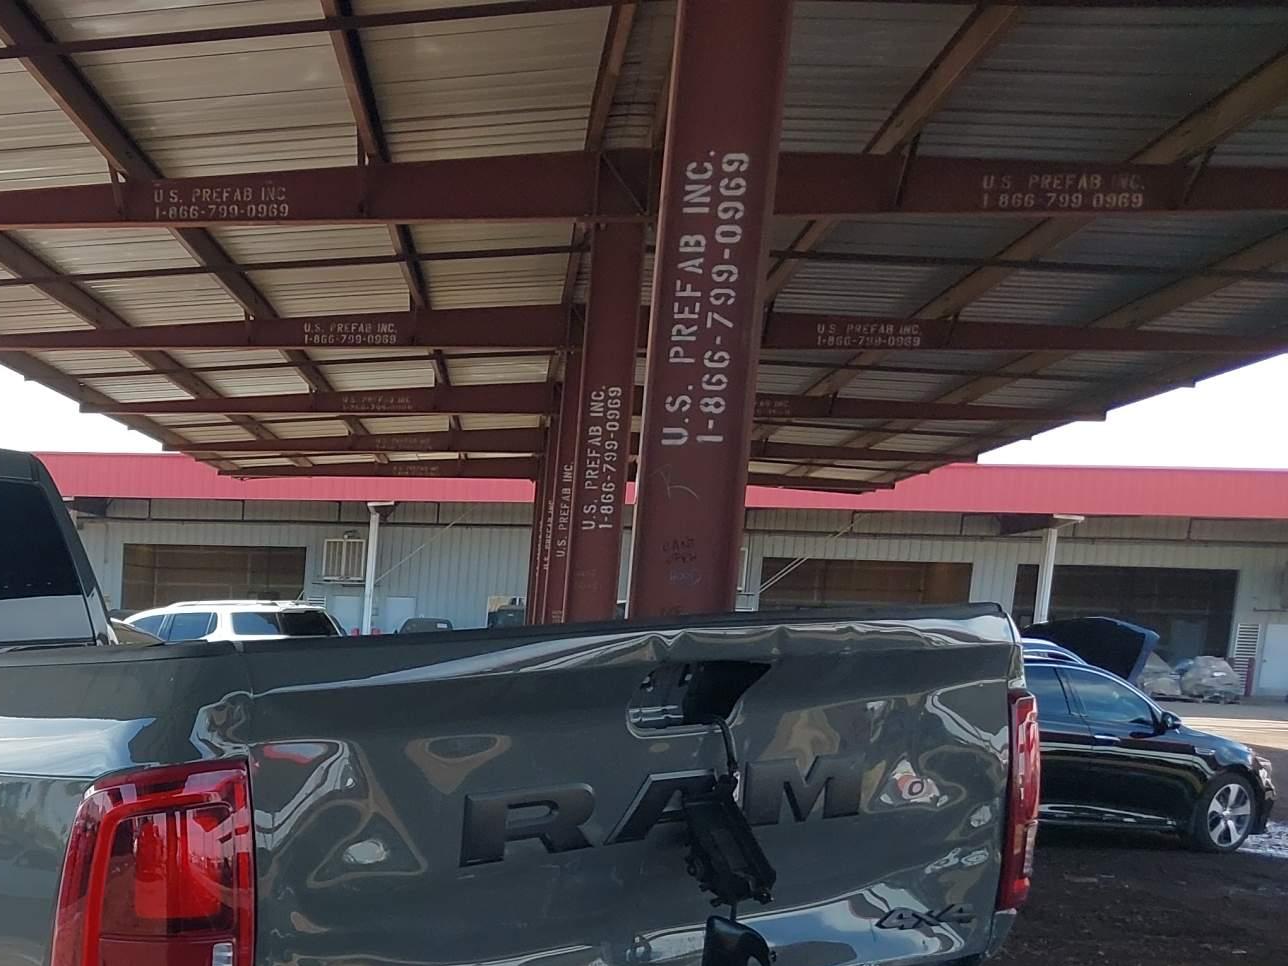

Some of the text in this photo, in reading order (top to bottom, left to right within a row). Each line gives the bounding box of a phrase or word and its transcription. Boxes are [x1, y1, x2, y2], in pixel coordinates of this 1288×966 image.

[154, 189, 183, 204] US.
[192, 187, 252, 203] PREFAB
[155, 204, 289, 220] 1-866-799-0969
[982, 192, 1144, 209] 18667990969
[1028, 174, 1102, 190] PREFAB
[661, 150, 716, 446] U.S. PREFAB INC.
[695, 152, 750, 443] 1-866-799-0969
[581, 385, 606, 530] U.S. PREFAB INC.
[598, 387, 621, 529] 1-866-799-0969
[558, 487, 572, 530] PREFAB
[459, 754, 865, 868] RAM
